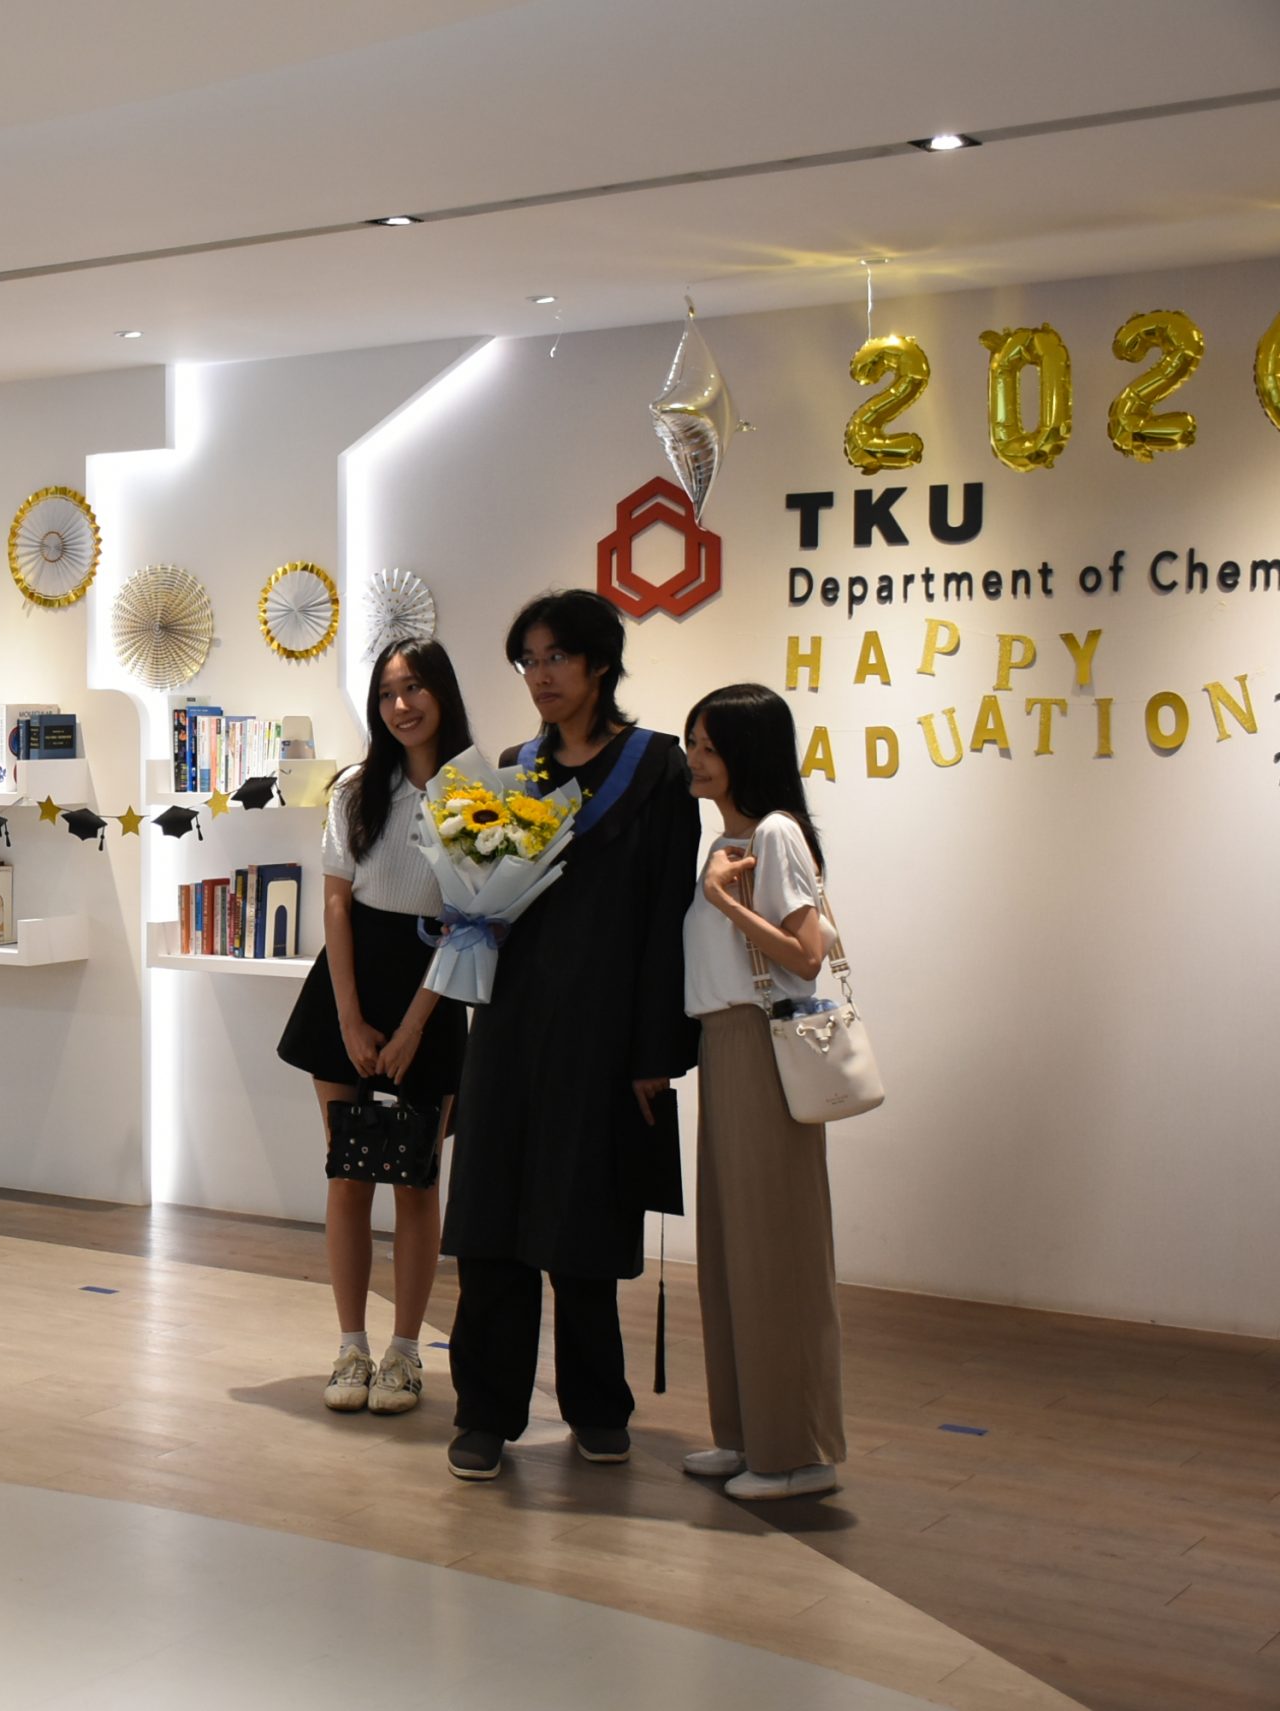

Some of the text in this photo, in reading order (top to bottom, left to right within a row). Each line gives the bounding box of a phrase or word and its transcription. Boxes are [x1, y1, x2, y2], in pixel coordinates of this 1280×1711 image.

[786, 482, 983, 549] TKU
[789, 559, 1053, 619] Department
[1079, 550, 1125, 594] of
[785, 618, 1102, 691] HAPPY
